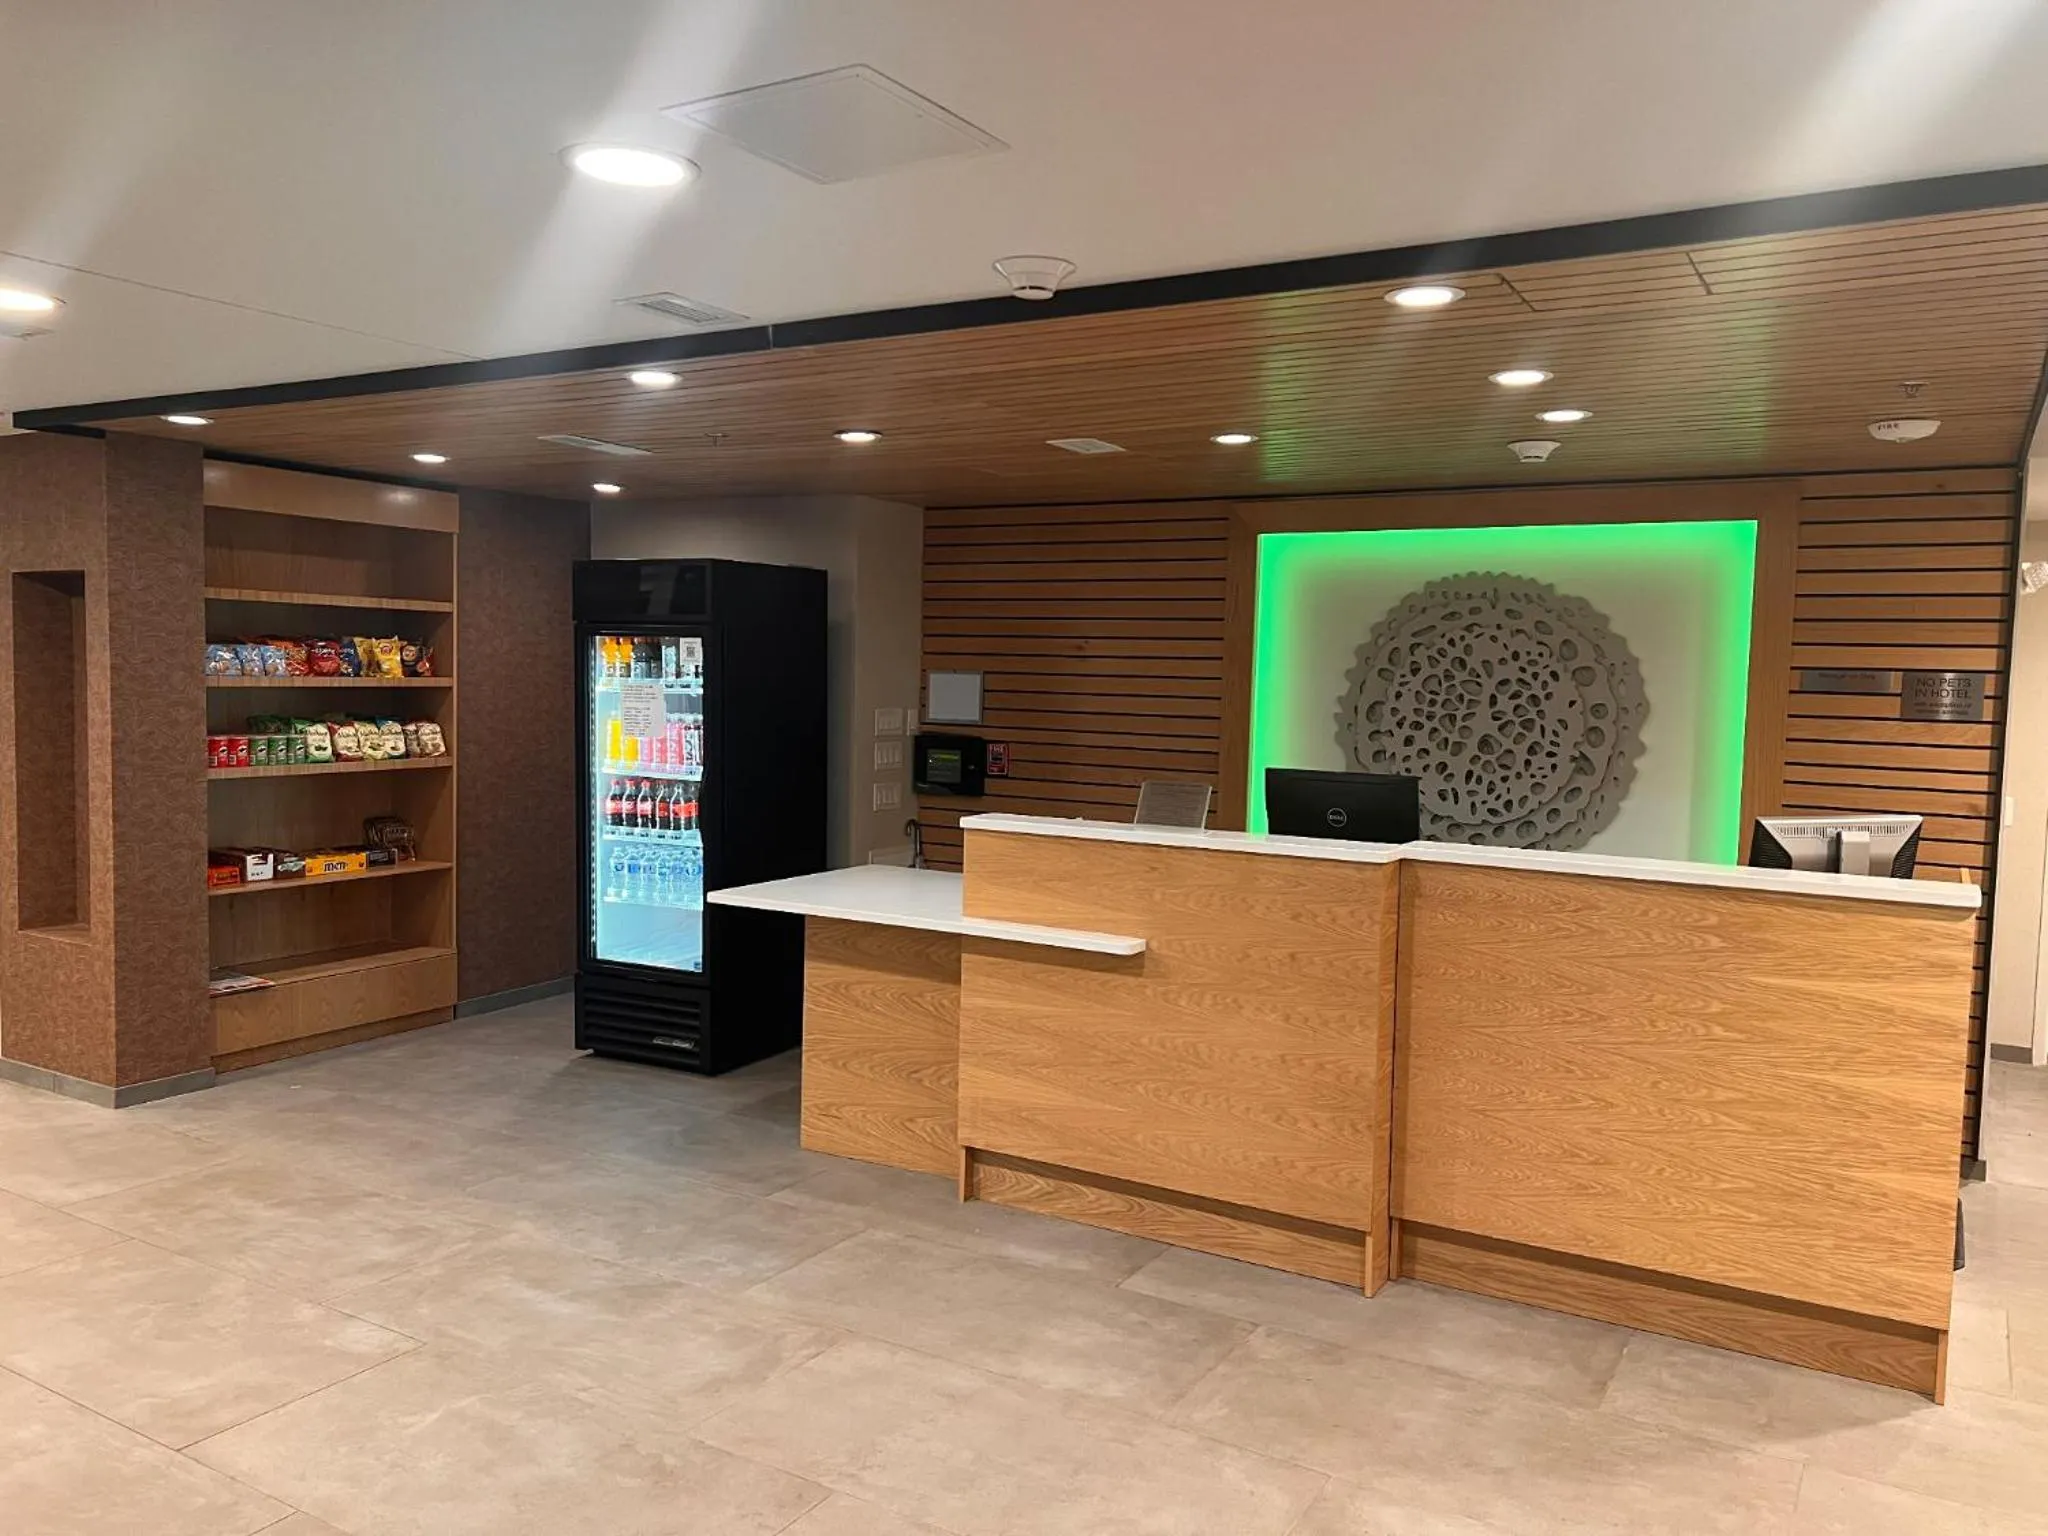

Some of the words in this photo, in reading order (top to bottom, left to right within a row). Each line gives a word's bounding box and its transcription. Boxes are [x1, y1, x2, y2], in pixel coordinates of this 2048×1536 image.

[1878, 422, 1900, 431] FIRE
[1916, 677, 1935, 688] NO
[1939, 678, 1971, 689] PETS
[1914, 688, 1928, 697] IN
[1931, 688, 1971, 699] HOTEL
